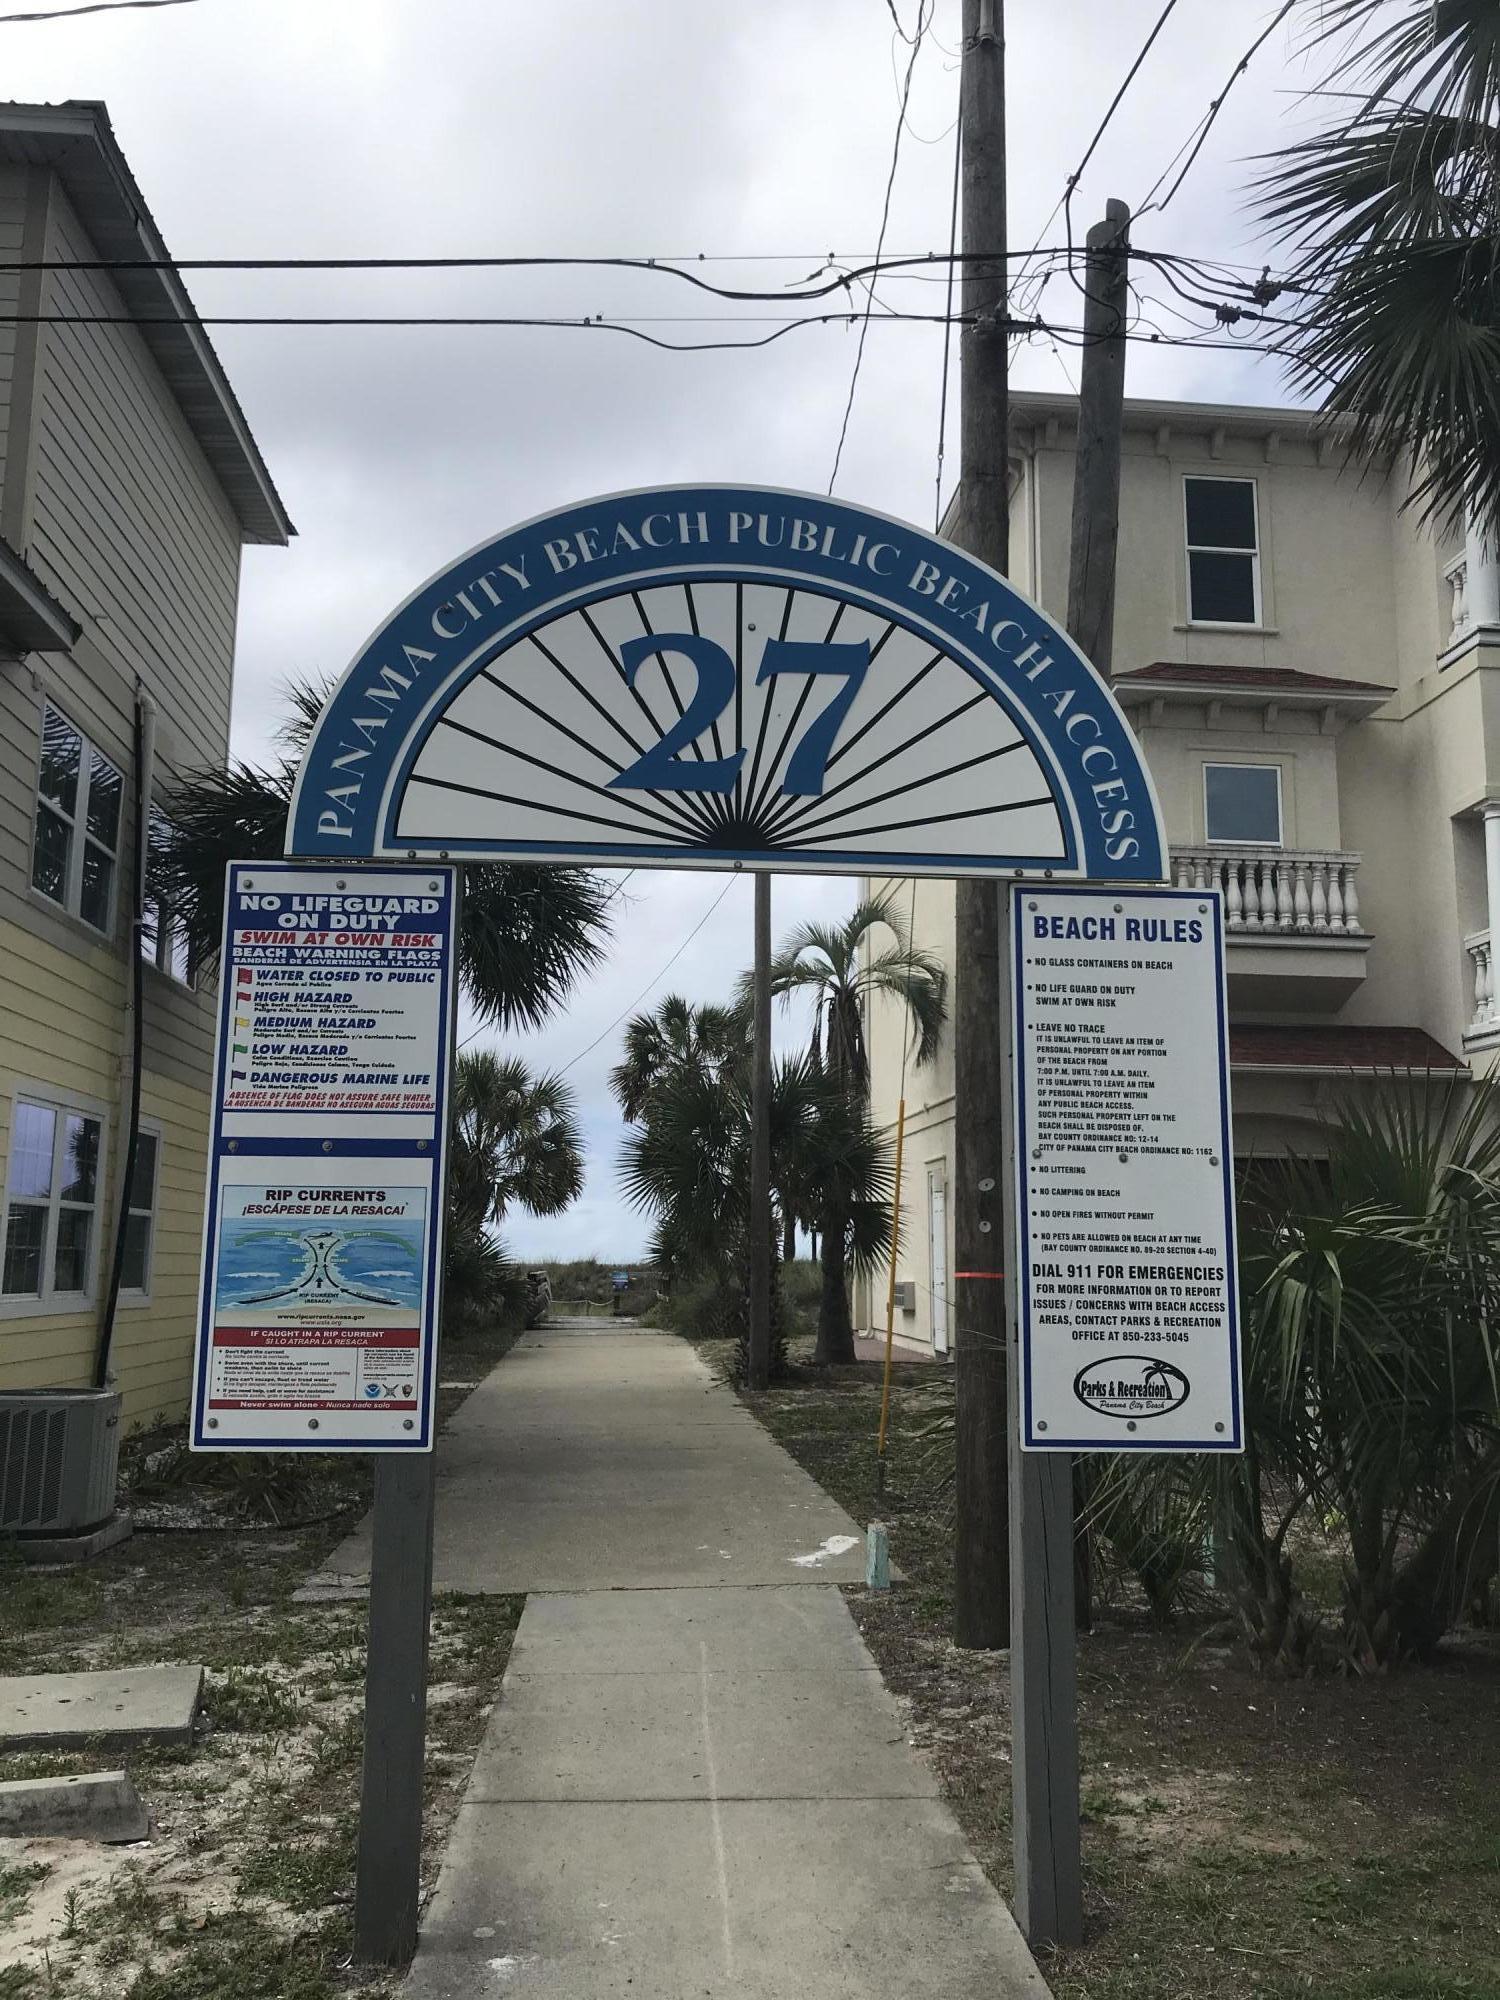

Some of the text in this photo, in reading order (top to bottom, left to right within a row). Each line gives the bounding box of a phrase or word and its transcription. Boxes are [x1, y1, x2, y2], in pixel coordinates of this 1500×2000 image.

[317, 511, 1139, 860] PANAMA CITY BEACH PUBLIC BEACH ACCESS
[604, 632, 873, 797] 27
[240, 896, 439, 913] NO LIFEGUARD
[278, 913, 400, 930] ON DUTY
[1034, 916, 1202, 943] BEACH RULES
[240, 932, 437, 946] SWIM AT OWN RISK
[232, 948, 441, 960] BEACH WARNING FLAGS
[1049, 959, 1074, 967] GLASS
[1077, 959, 1129, 968] CONTAINERS
[1145, 961, 1173, 969] BEACH
[256, 970, 435, 983] WATER CLOSED TO PUBLIC
[1036, 984, 1046, 992] NO
[1069, 985, 1097, 993] GUARD
[254, 992, 353, 1003] HIGH HAZARD
[1097, 999, 1116, 1007] RISK
[254, 1017, 376, 1029] MEDIUM HAZARD
[1078, 1025, 1105, 1033] TRACE
[252, 1044, 348, 1055] LOW HAZARD
[250, 1073, 430, 1085] DANGEROUS MARINE LIFE
[282, 1092, 302, 1100] FLAG
[305, 1092, 325, 1100] DOES
[346, 1093, 378, 1101] ASSURE
[380, 1093, 401, 1101] SAFE
[1105, 1102, 1134, 1110] ACCESS.
[266, 1190, 386, 1201] RIP CURRENTS
[242, 1202, 310, 1215] ¡ESCÁPESE
[314, 1205, 330, 1214] DE
[333, 1206, 349, 1214] LA
[1128, 1212, 1154, 1220] PERMIT
[1033, 1264, 1224, 1280] DIAL 911 FOR EMERGENCIES
[1037, 1284, 1221, 1296] FOR MORE INFORMATION OR TO REPORT
[1033, 1300, 1066, 1309] ISSUES
[1076, 1300, 1126, 1310] CONCERNS
[1129, 1301, 1152, 1310] WITH
[1156, 1302, 1186, 1311] BEACH
[1189, 1303, 1225, 1312] ACCESS
[1039, 1315, 1221, 1327] AREAS, CONTACT PARKS & RECREATION
[1072, 1331, 1189, 1342] OFFICE AT 850-233-5045
[1080, 1380, 1166, 1397] Parks & Recreation
[1129, 1401, 1144, 1410] City
